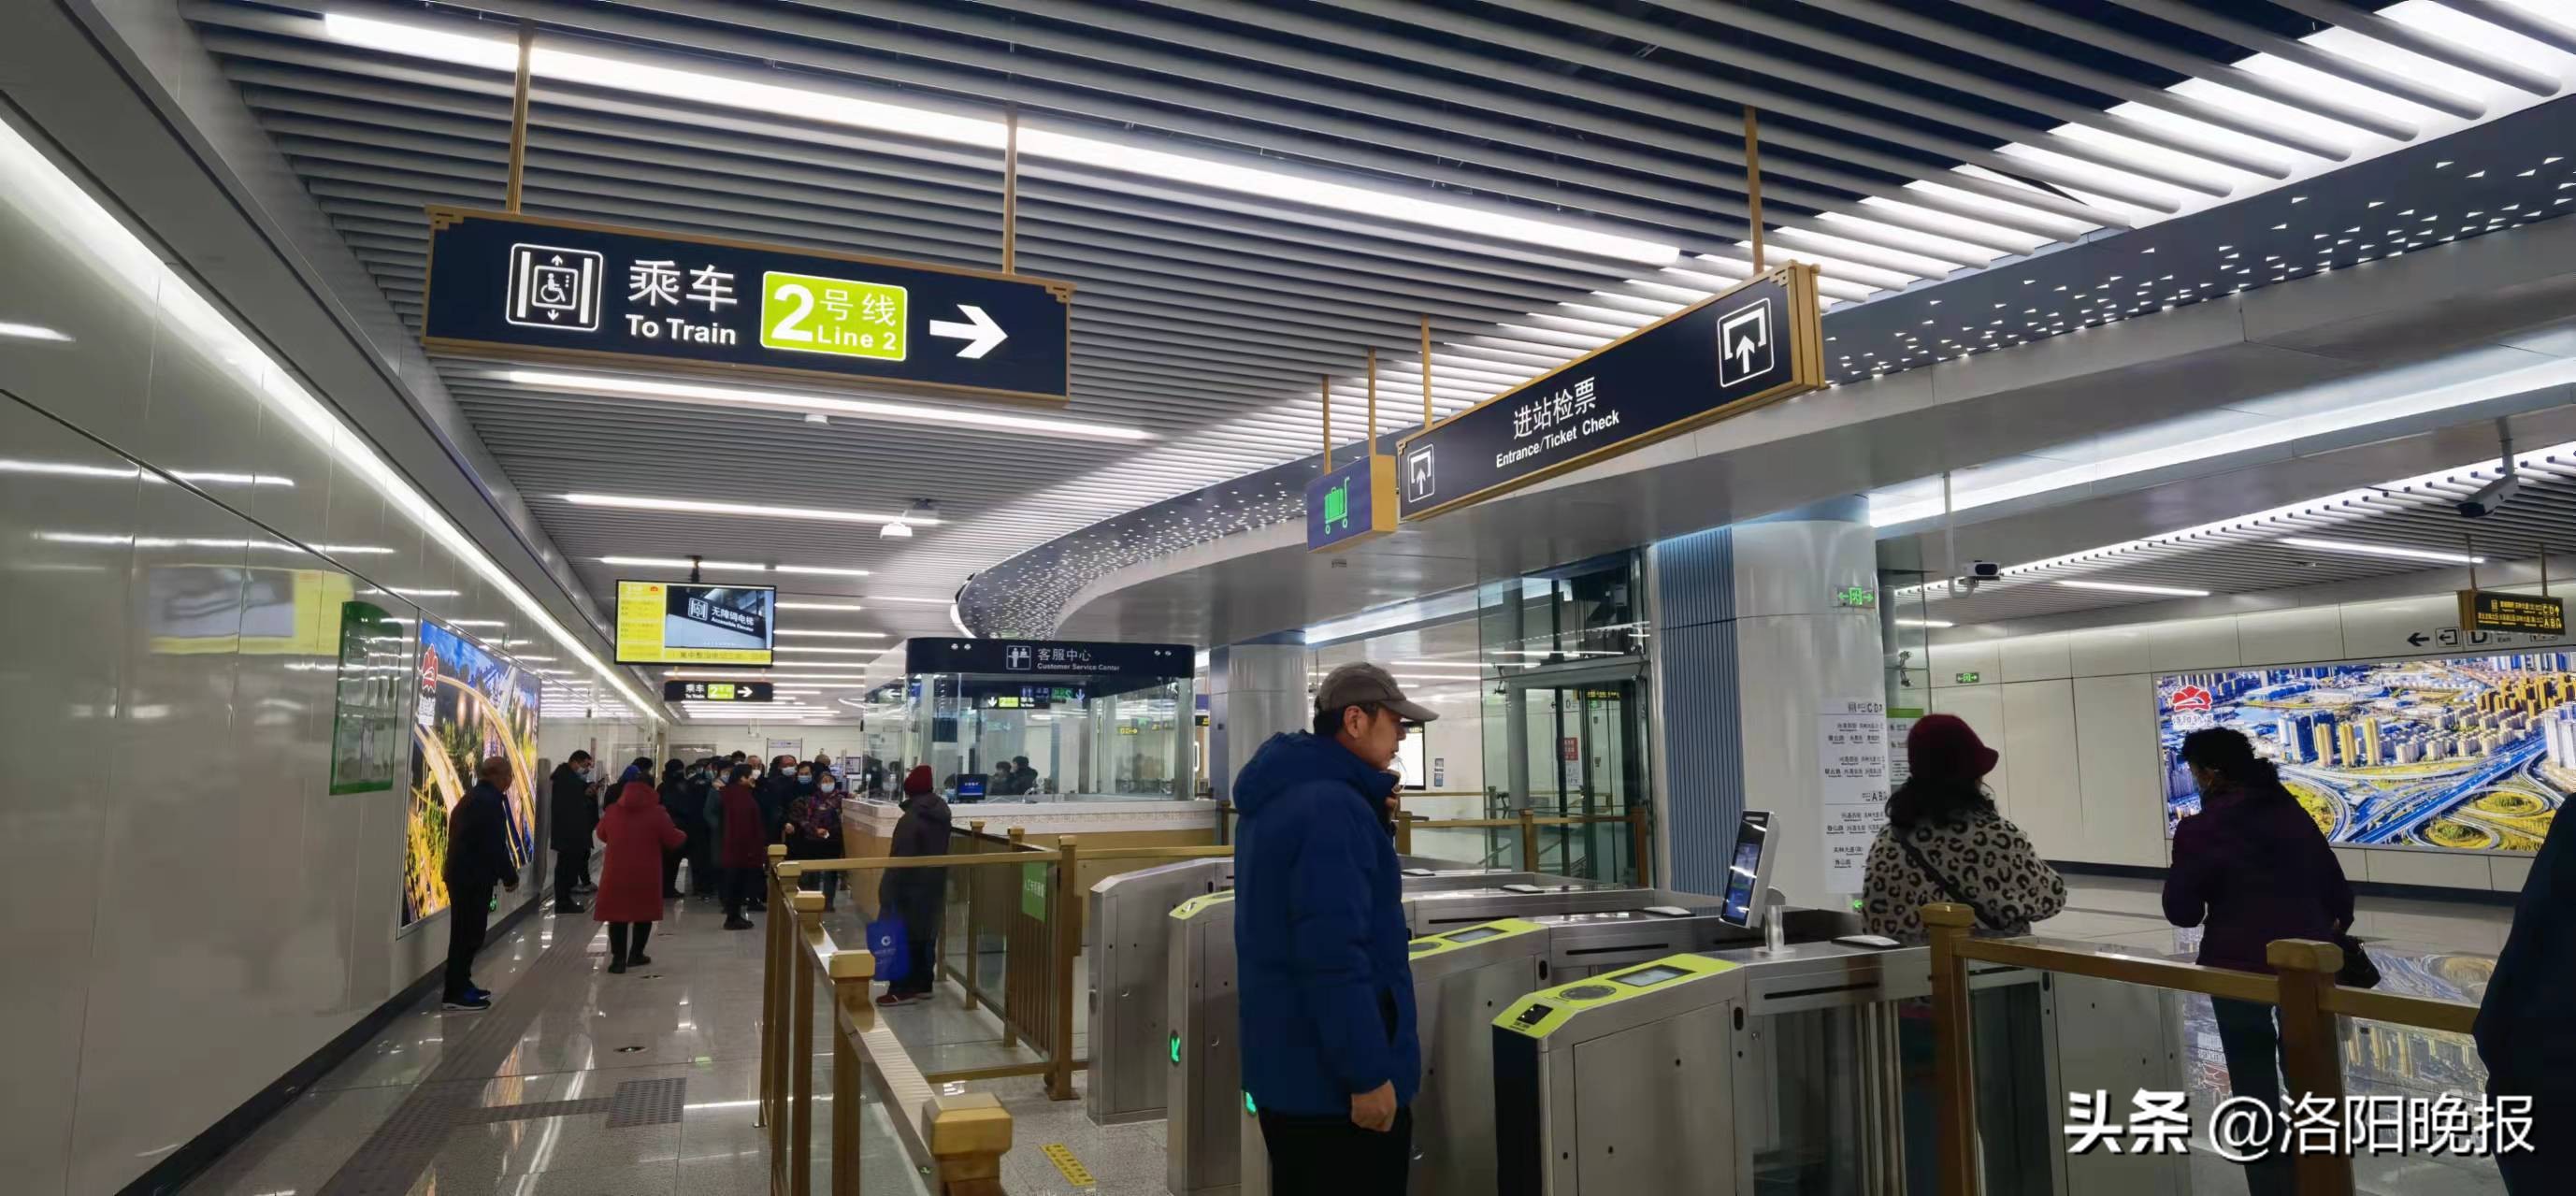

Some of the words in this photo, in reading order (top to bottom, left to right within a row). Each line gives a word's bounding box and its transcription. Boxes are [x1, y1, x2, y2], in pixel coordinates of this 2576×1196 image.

[627, 259, 738, 312] 乘车
[626, 313, 659, 338] To
[666, 317, 737, 345] Train
[817, 324, 874, 348] Line
[883, 332, 897, 351] 2
[1513, 376, 1597, 440] 进站检票
[1496, 425, 1577, 468] Entrance/Ticket
[1582, 409, 1619, 436] Check
[1037, 647, 1092, 662] 客服中心
[1037, 662, 1071, 670] Customer
